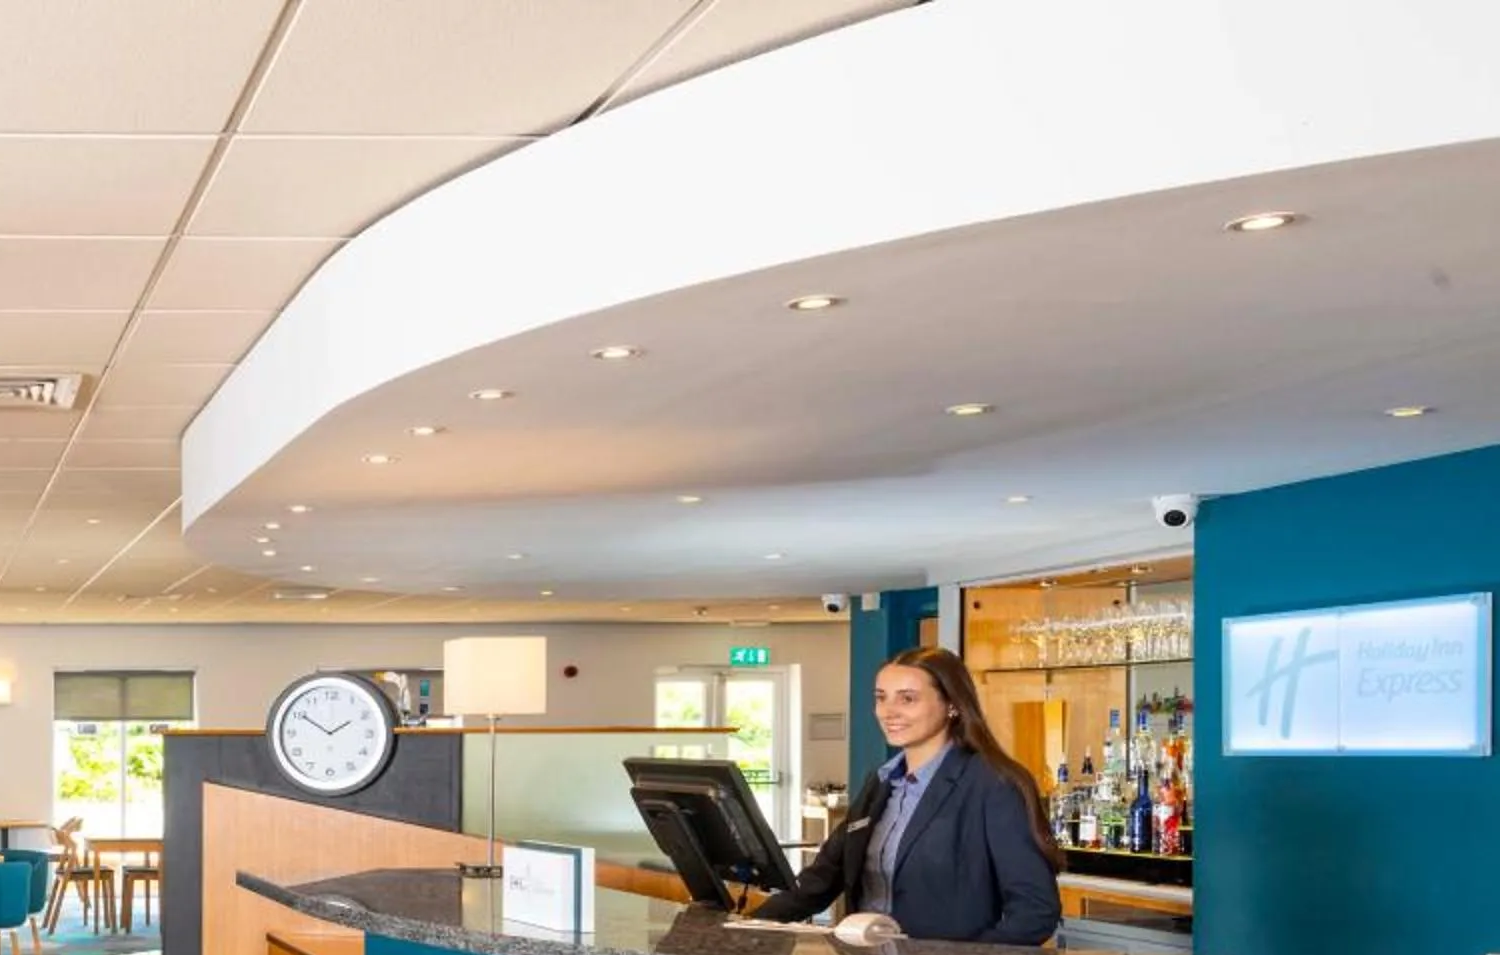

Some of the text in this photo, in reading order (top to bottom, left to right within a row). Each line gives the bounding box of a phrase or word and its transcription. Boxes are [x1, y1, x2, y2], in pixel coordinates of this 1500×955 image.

[1357, 637, 1463, 662] Holiday Inn
[1357, 667, 1463, 702] Express
[325, 690, 339, 701] 12
[306, 696, 317, 705] 11
[365, 729, 374, 739] 3
[358, 747, 368, 756] 4
[306, 761, 315, 770] 7
[325, 767, 335, 776] 6
